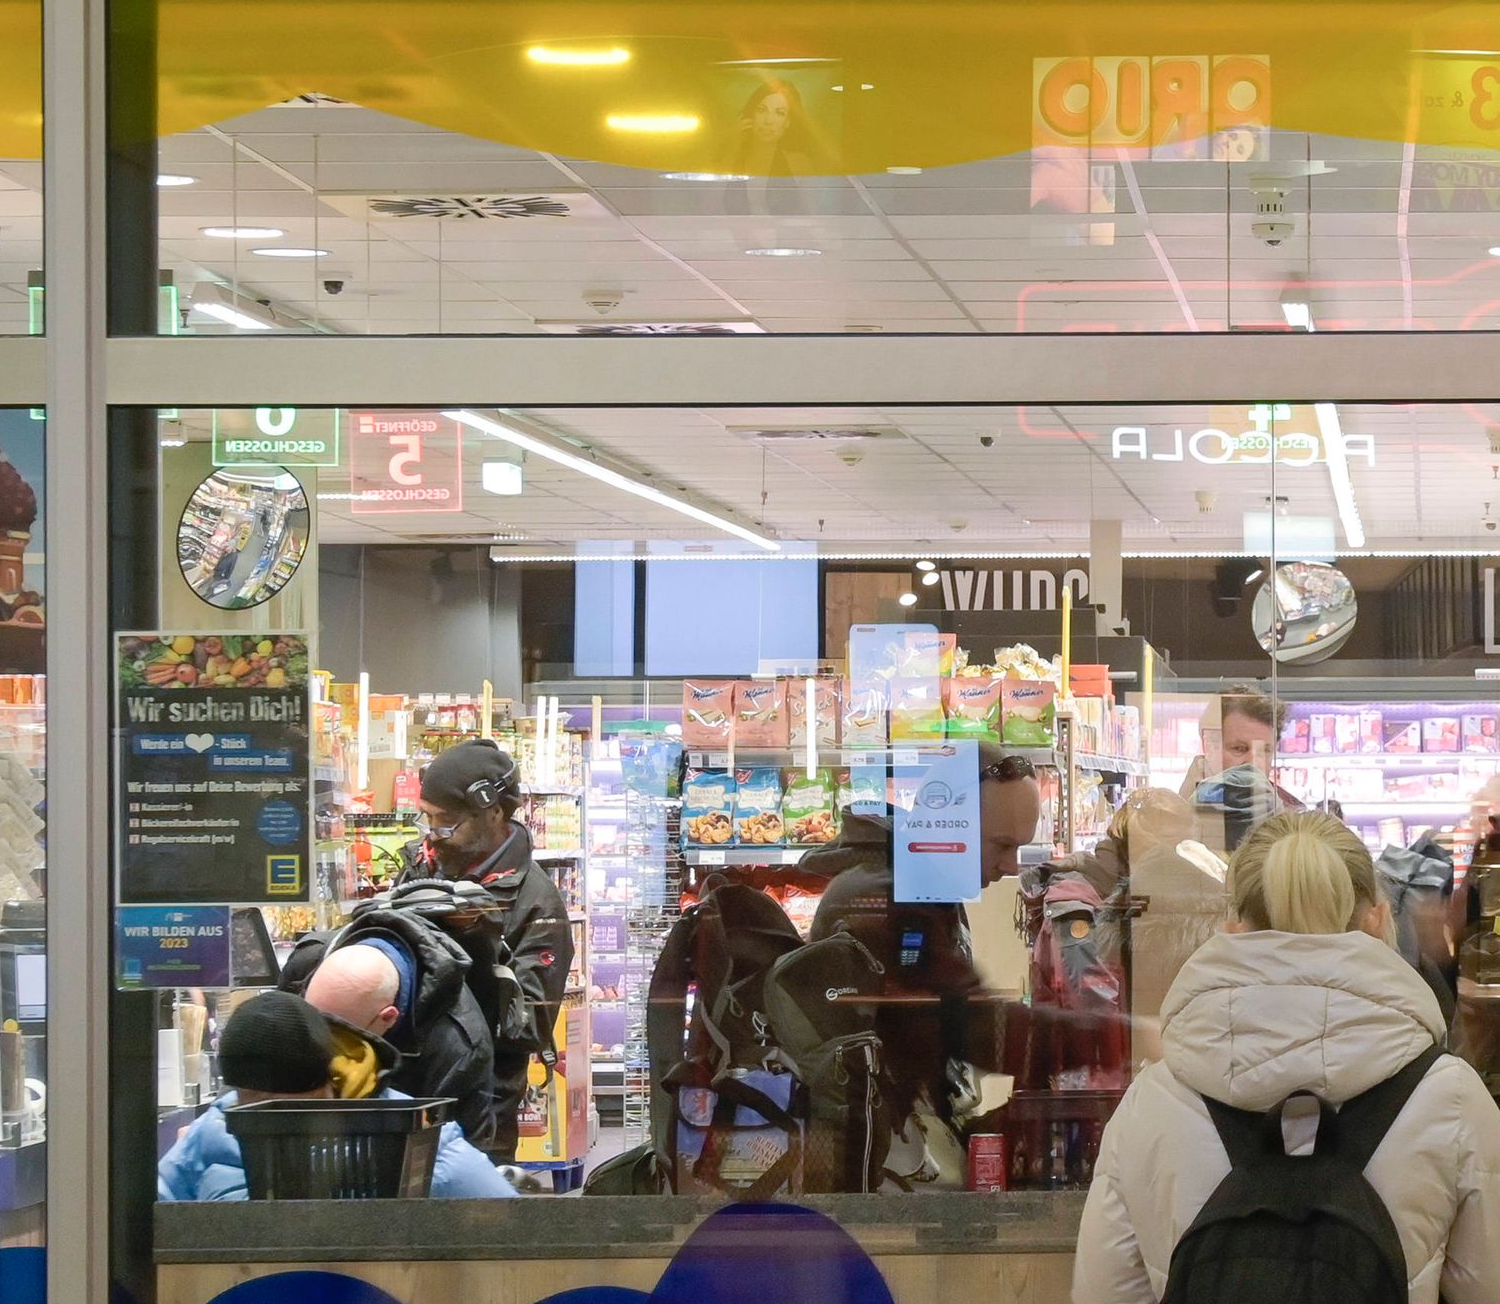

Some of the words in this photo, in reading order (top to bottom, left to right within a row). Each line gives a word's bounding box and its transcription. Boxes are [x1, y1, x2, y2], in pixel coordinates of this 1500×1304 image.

[127, 696, 164, 723] Wir
[169, 696, 244, 723] suchen
[250, 695, 301, 723] Dich!
[124, 926, 149, 937] WIR
[152, 926, 195, 937] BILDEN
[197, 926, 224, 937] AUS
[160, 938, 189, 948] 2023
